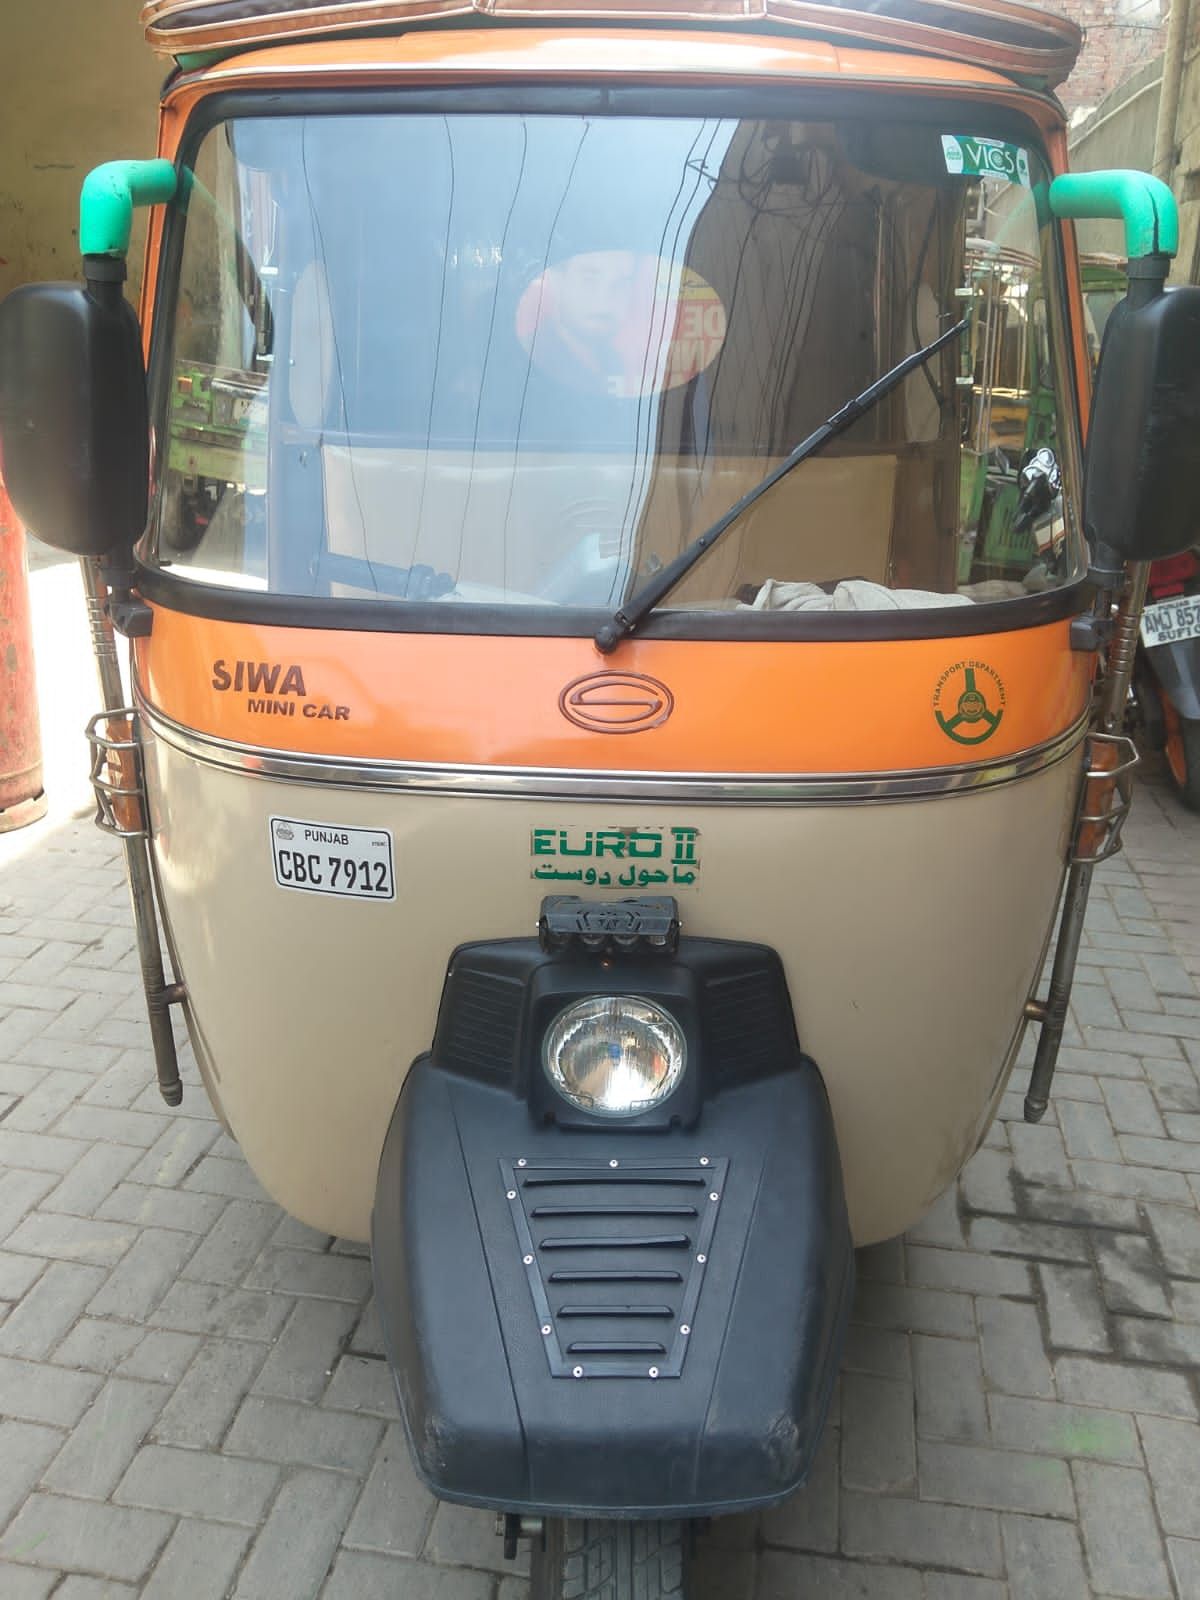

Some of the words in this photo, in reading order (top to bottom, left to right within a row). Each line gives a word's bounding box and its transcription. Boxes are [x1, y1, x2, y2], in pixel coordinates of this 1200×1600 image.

[966, 143, 1015, 174] VICS
[1144, 609, 1173, 635] AMJ
[211, 659, 307, 697] SIWA
[932, 661, 966, 706] TRANSPORT
[968, 661, 1006, 705] DEPARTMENT
[247, 698, 295, 717] MINI
[302, 703, 351, 721] CAR
[304, 829, 350, 846] PUNJAB
[533, 828, 663, 859] EURO
[278, 849, 322, 885] CBC
[328, 856, 389, 892] 7912
[533, 863, 612, 886] دوست
[617, 864, 697, 887] ماحول
